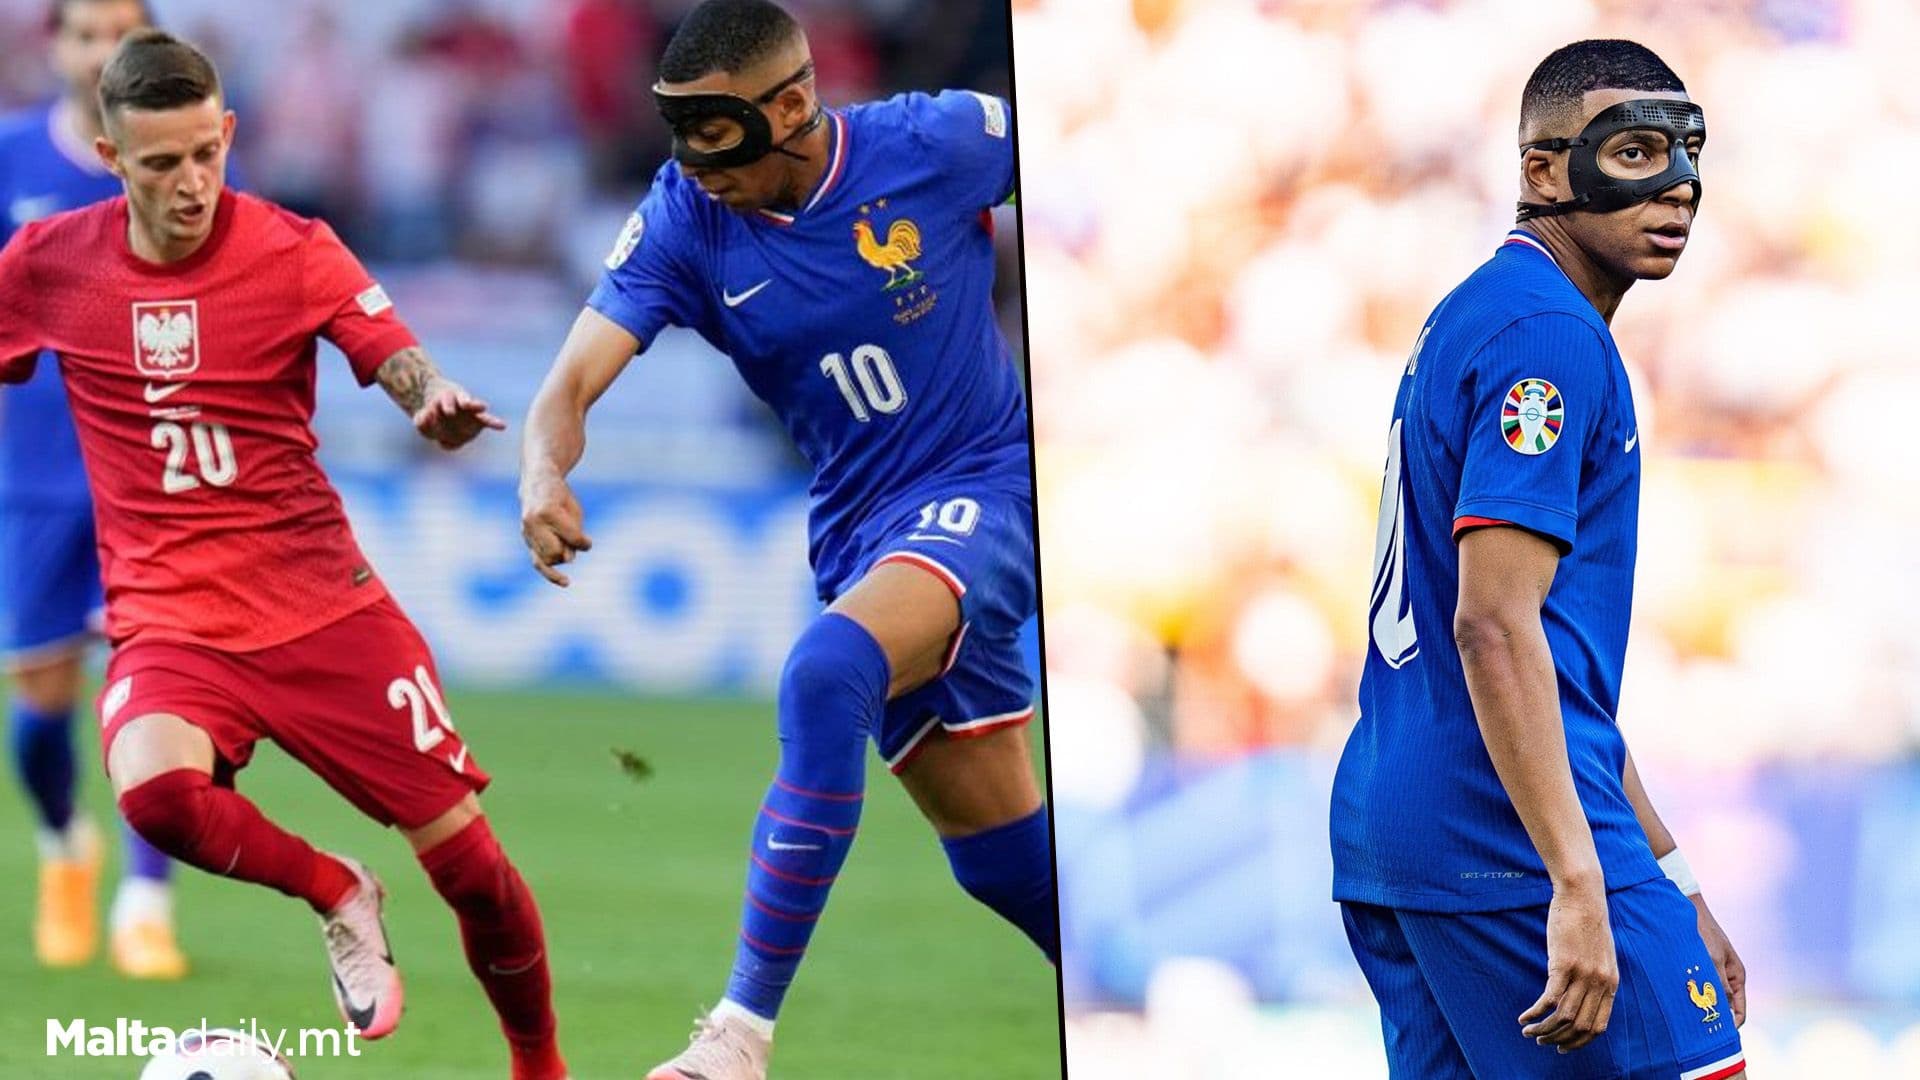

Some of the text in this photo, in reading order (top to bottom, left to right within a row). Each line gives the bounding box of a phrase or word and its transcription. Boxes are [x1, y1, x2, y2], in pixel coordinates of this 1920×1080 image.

[820, 344, 908, 422] 10
[151, 422, 238, 494] 20
[917, 498, 980, 536] 10
